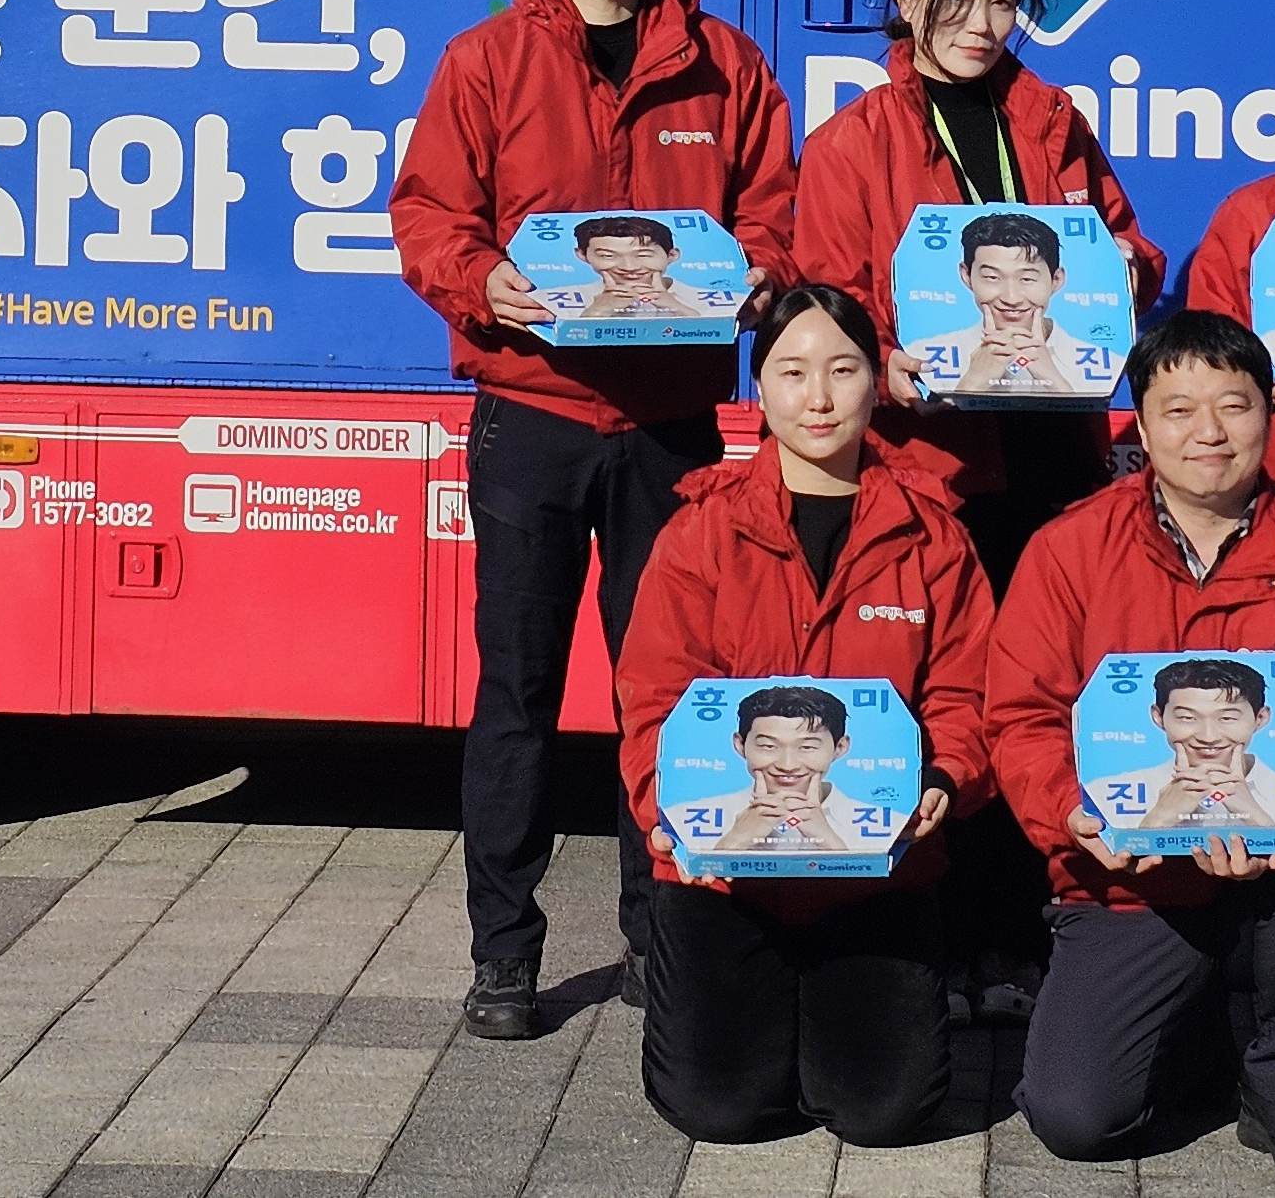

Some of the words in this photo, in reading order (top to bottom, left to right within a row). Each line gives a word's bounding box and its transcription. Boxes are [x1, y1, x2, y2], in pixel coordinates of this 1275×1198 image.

[530, 217, 564, 241] 흥
[673, 216, 709, 233] 미
[918, 213, 952, 251] 흥
[1063, 216, 1098, 245] 미
[105, 296, 197, 330] More
[207, 298, 274, 332] Fun
[547, 292, 586, 309] 진
[697, 290, 737, 307] 진
[924, 345, 962, 380] 진
[1075, 347, 1113, 381] 진
[216, 423, 328, 450] DOMINO'S
[335, 426, 410, 452] ORDER
[30, 475, 96, 499] Phone
[246, 480, 361, 511] Homepage
[31, 502, 153, 527] 1577-3082
[245, 506, 399, 535] dominos.co.kr
[1106, 659, 1143, 694] 흥
[691, 687, 728, 722] 흥
[852, 688, 889, 714] 미
[1106, 783, 1147, 815] 진
[684, 807, 723, 838] 진
[852, 806, 892, 838] 진
